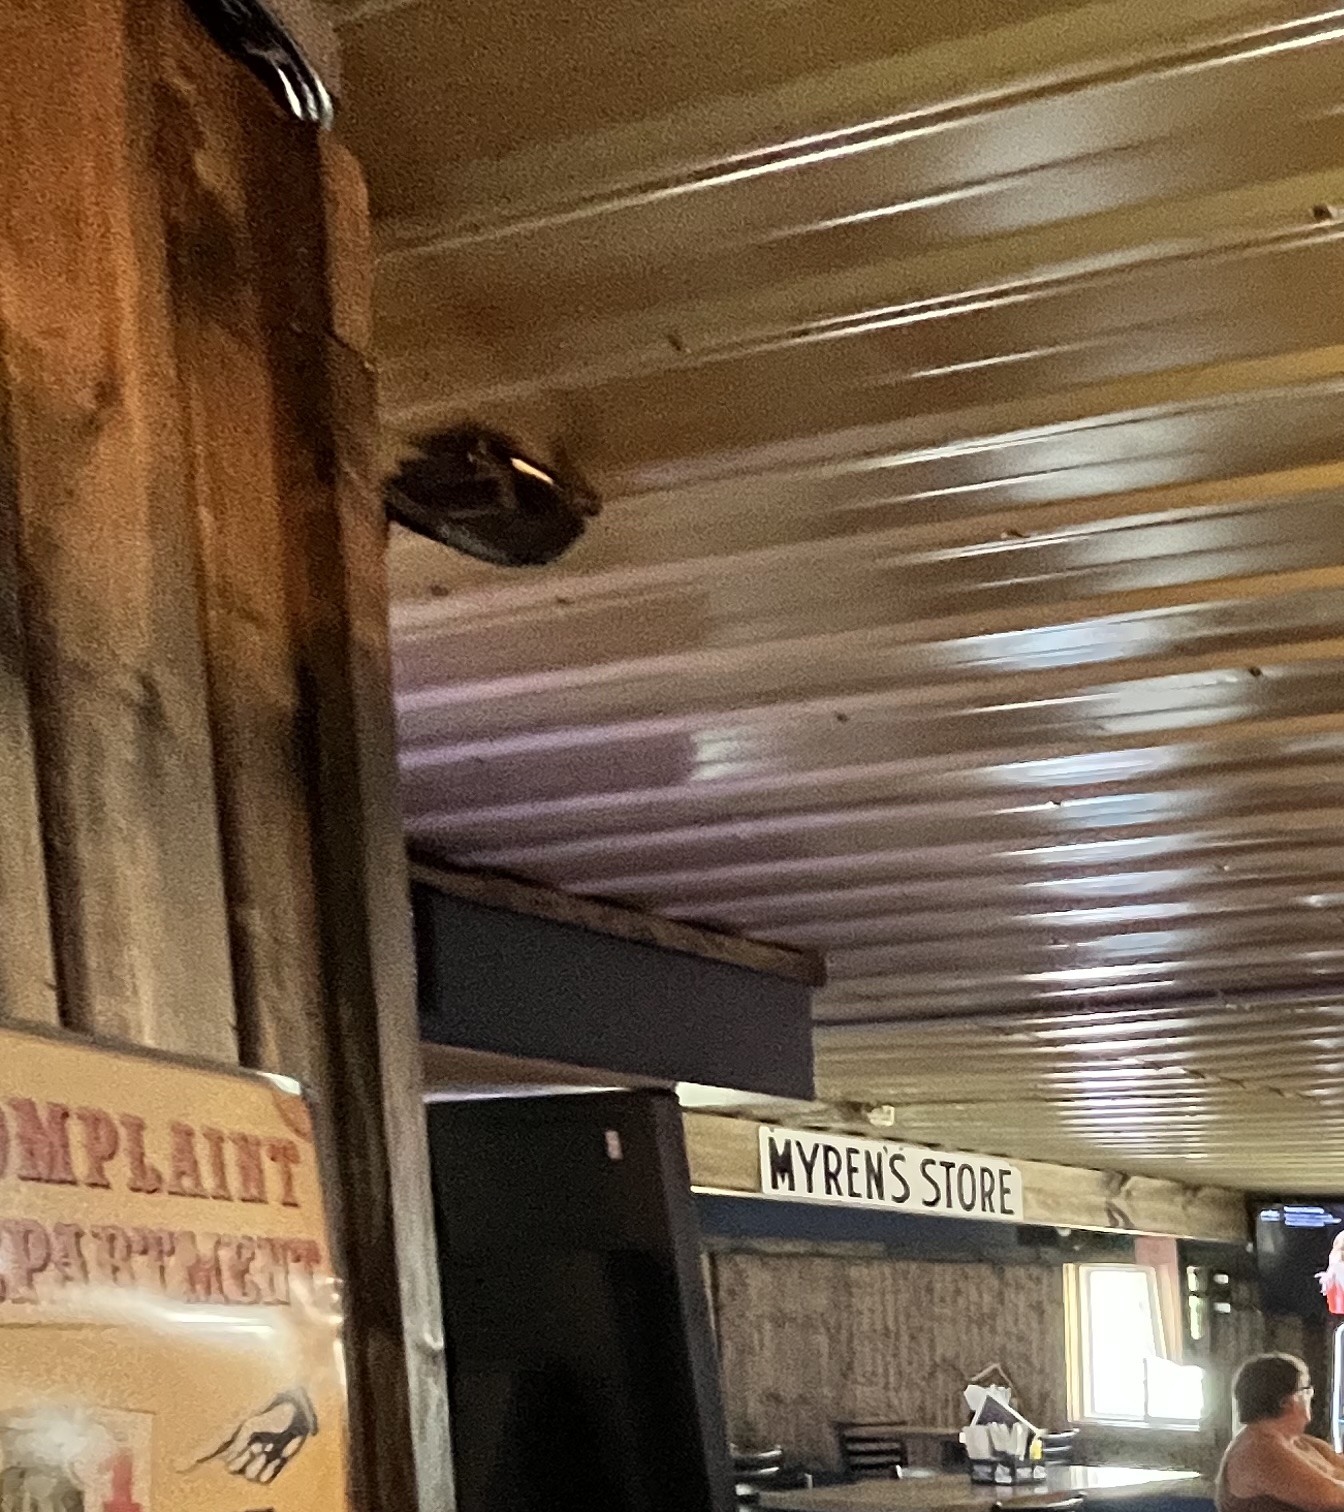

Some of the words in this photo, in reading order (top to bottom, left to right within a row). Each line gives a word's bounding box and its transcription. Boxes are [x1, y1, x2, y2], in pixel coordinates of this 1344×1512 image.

[0, 1098, 300, 1208] MPLAINT
[767, 1136, 910, 1204] MYREN'S
[920, 1157, 1016, 1217] STORE
[0, 1217, 321, 1305] PARTMENT
